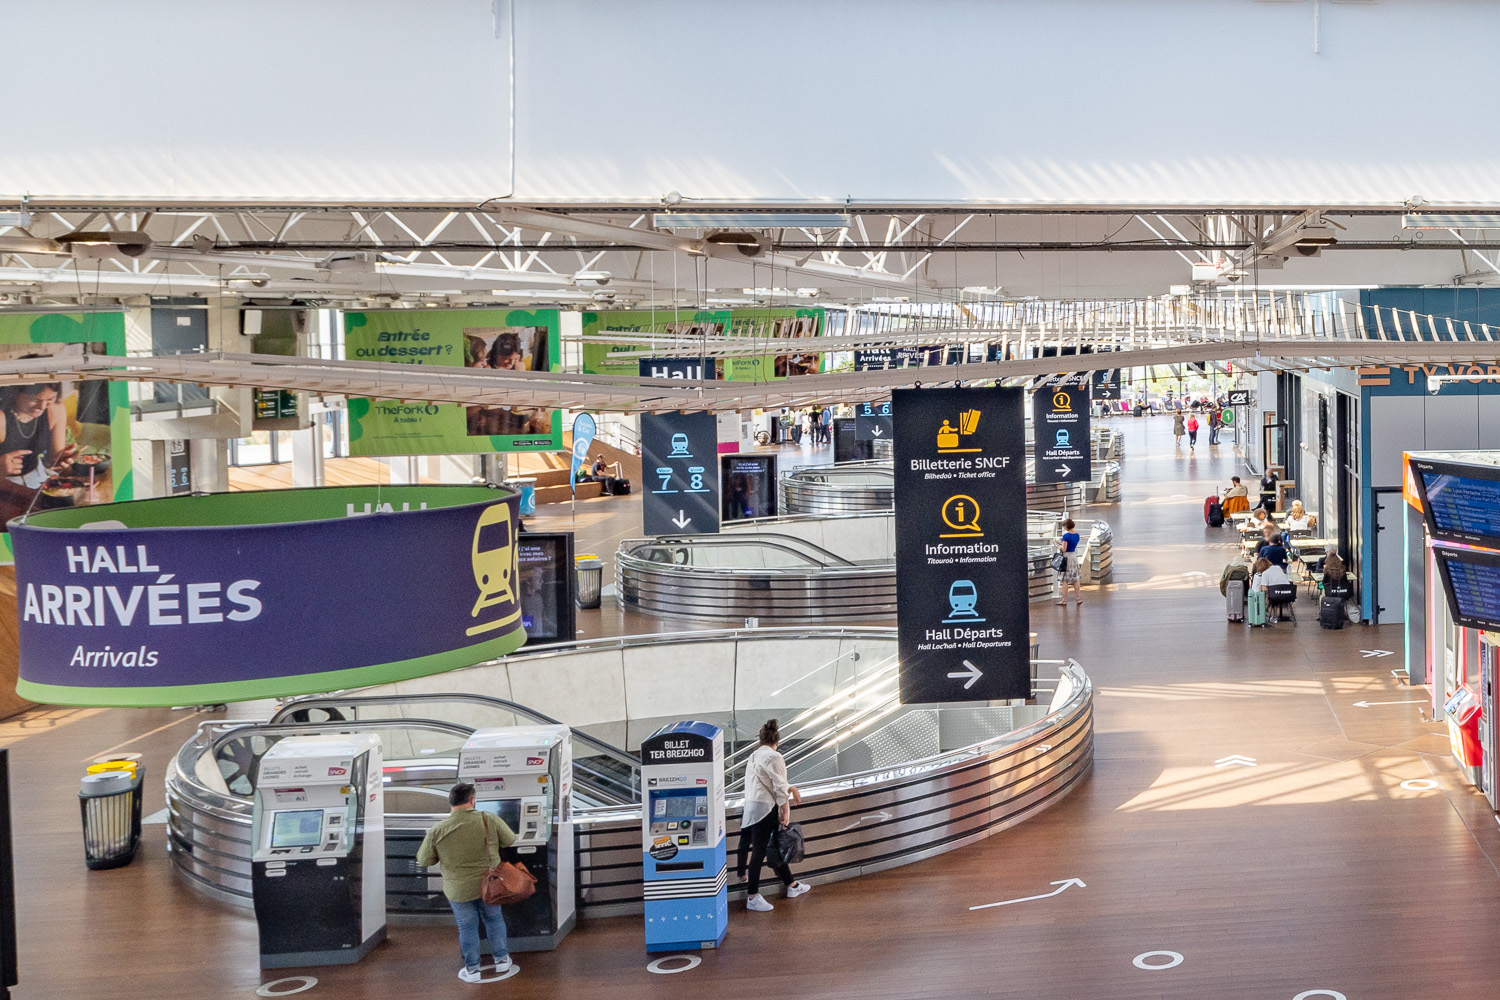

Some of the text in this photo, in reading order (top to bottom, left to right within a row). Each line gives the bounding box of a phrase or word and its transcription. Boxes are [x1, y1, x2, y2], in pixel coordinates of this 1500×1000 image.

[378, 329, 430, 342] Entrée
[356, 344, 453, 357] ou dessert ?
[860, 354, 892, 363] Arrivées
[375, 405, 424, 416] TheFork
[864, 404, 890, 415] 5 6
[1225, 412, 1231, 421] 1
[910, 457, 1010, 471] Billetterie SNCF
[658, 474, 703, 490] 7 8
[925, 542, 999, 555] Information
[66, 545, 160, 573] HALL
[960, 556, 997, 564] Information
[23, 574, 263, 626] ARRIVÉES
[925, 627, 1003, 641] Hall Départs
[977, 640, 1012, 649] Departures
[70, 645, 159, 667] Arrivals
[664, 740, 690, 749] BILLET
[650, 749, 705, 759] TER BREIZHGO
